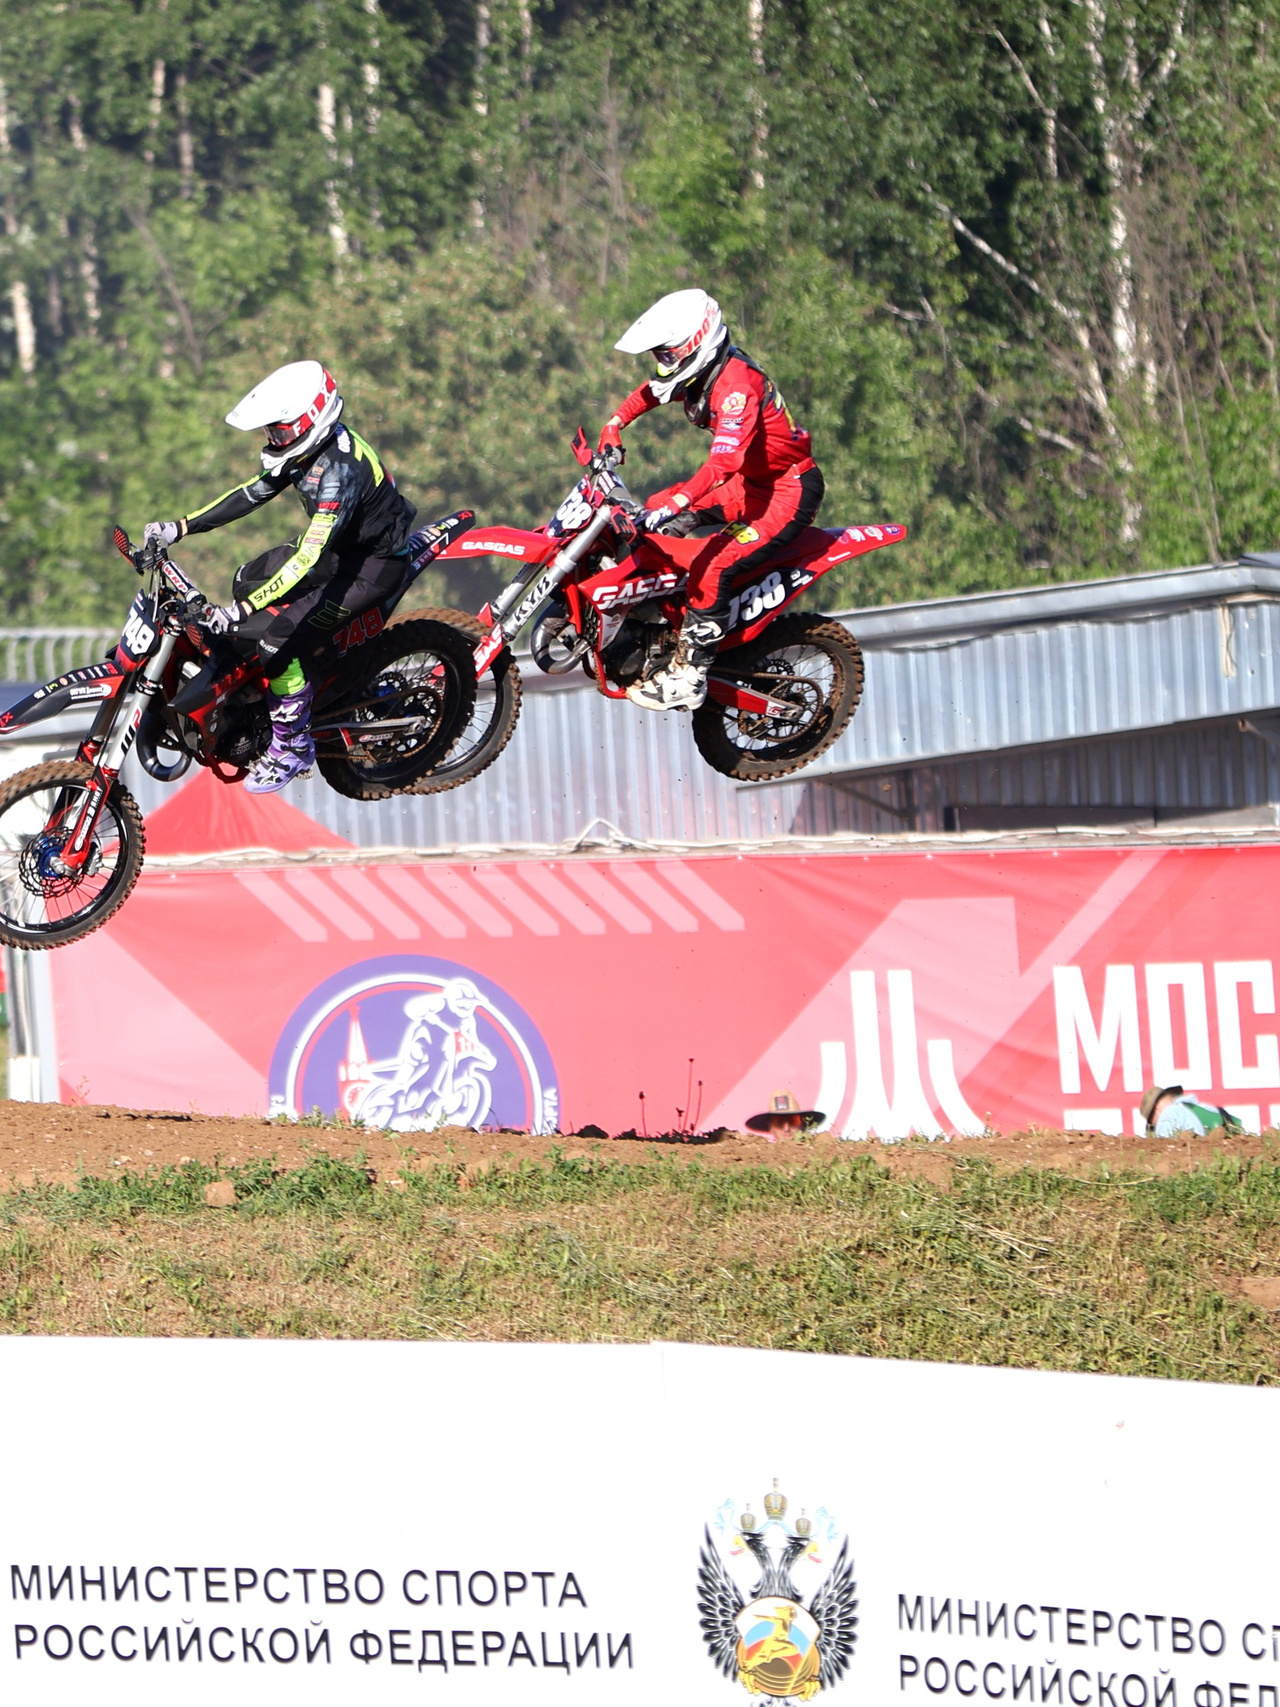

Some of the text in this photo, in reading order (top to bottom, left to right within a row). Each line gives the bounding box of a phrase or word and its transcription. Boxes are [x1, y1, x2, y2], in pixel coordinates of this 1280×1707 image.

[292, 373, 337, 438] FOX
[461, 541, 526, 556] GASGAS
[163, 566, 188, 593] WRP
[253, 575, 285, 602] SHOT
[592, 573, 688, 611] GASG
[727, 571, 786, 630] 138
[259, 639, 280, 654] SHOT
[333, 606, 385, 657] 748
[1053, 960, 1280, 1094] МОС
[10, 1564, 587, 1608] МИНИСТЕРСТВО СПОРТА
[14, 1618, 633, 1676] РОССИЙСКОЙ ФЕДЕРАЦИИ
[898, 1593, 1227, 1657] МИНИСТЕРСТВО
[899, 1654, 1177, 1707] РОССИЙСКОЙ
